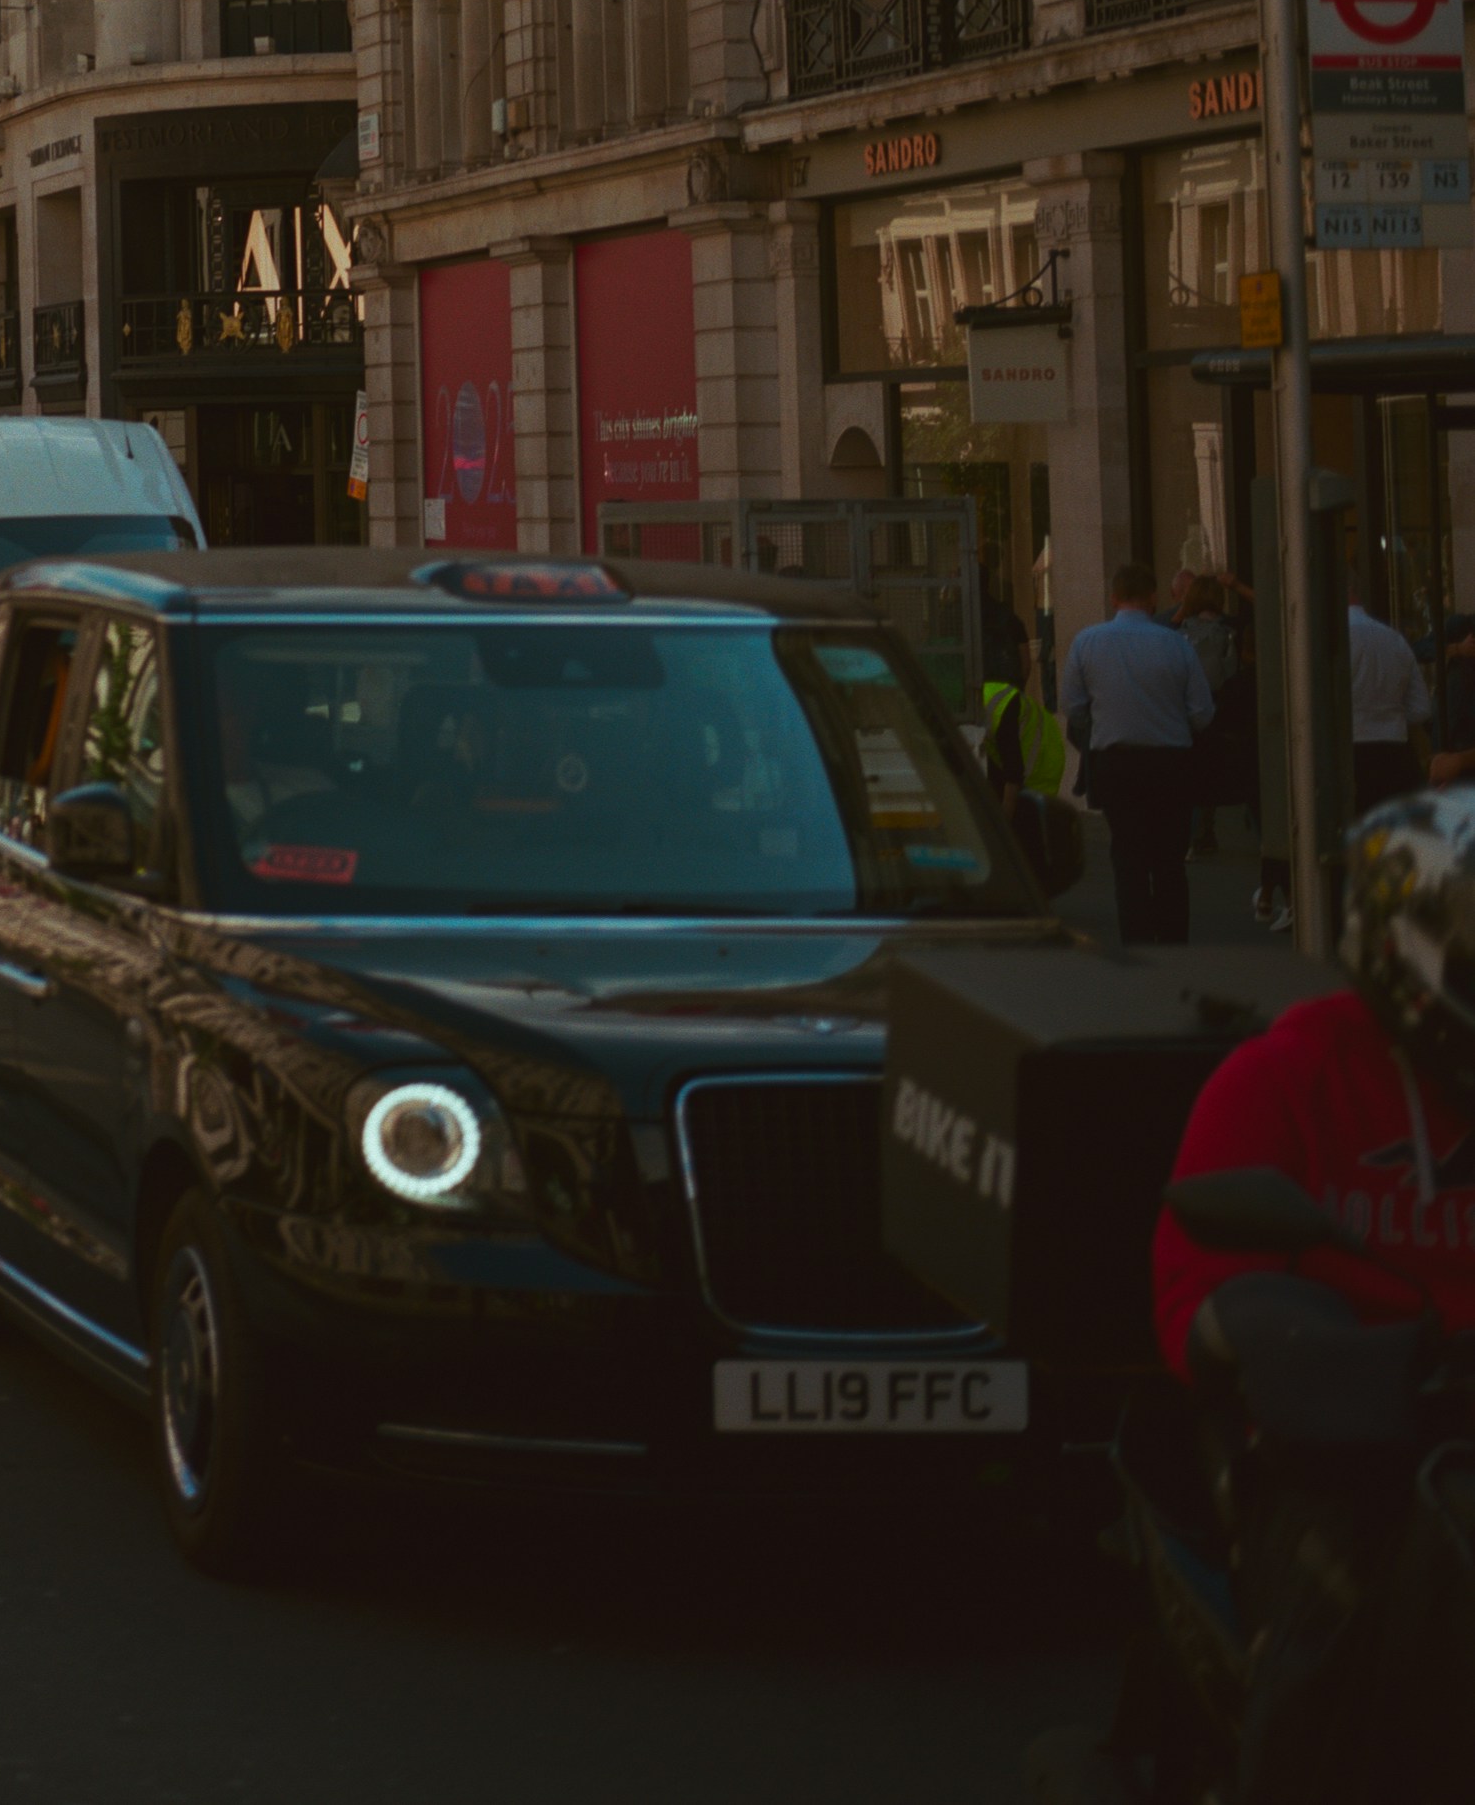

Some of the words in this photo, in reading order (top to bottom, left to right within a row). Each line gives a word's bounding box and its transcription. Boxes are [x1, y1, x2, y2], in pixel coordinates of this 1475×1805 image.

[1358, 57, 1382, 67] BUS
[1386, 57, 1418, 67] STOP
[1349, 77, 1382, 90] Beak
[1388, 77, 1430, 91] Street
[1189, 70, 1263, 120] SAND
[1349, 136, 1388, 149] Baker
[1392, 136, 1434, 150] Street
[864, 132, 938, 177] SANDRO
[1331, 173, 1351, 190] 12
[1378, 173, 1410, 189] 139
[1433, 172, 1459, 189] N3
[1324, 218, 1363, 235] N15
[1372, 218, 1421, 234] N113
[981, 366, 1056, 382] SANDRO
[593, 410, 613, 441] This
[614, 410, 630, 448] city
[632, 409, 660, 440] shines
[662, 405, 698, 447] brighte
[893, 1076, 976, 1183] BIKE
[752, 1372, 870, 1424] LL19
[888, 1372, 991, 1422] FFC
